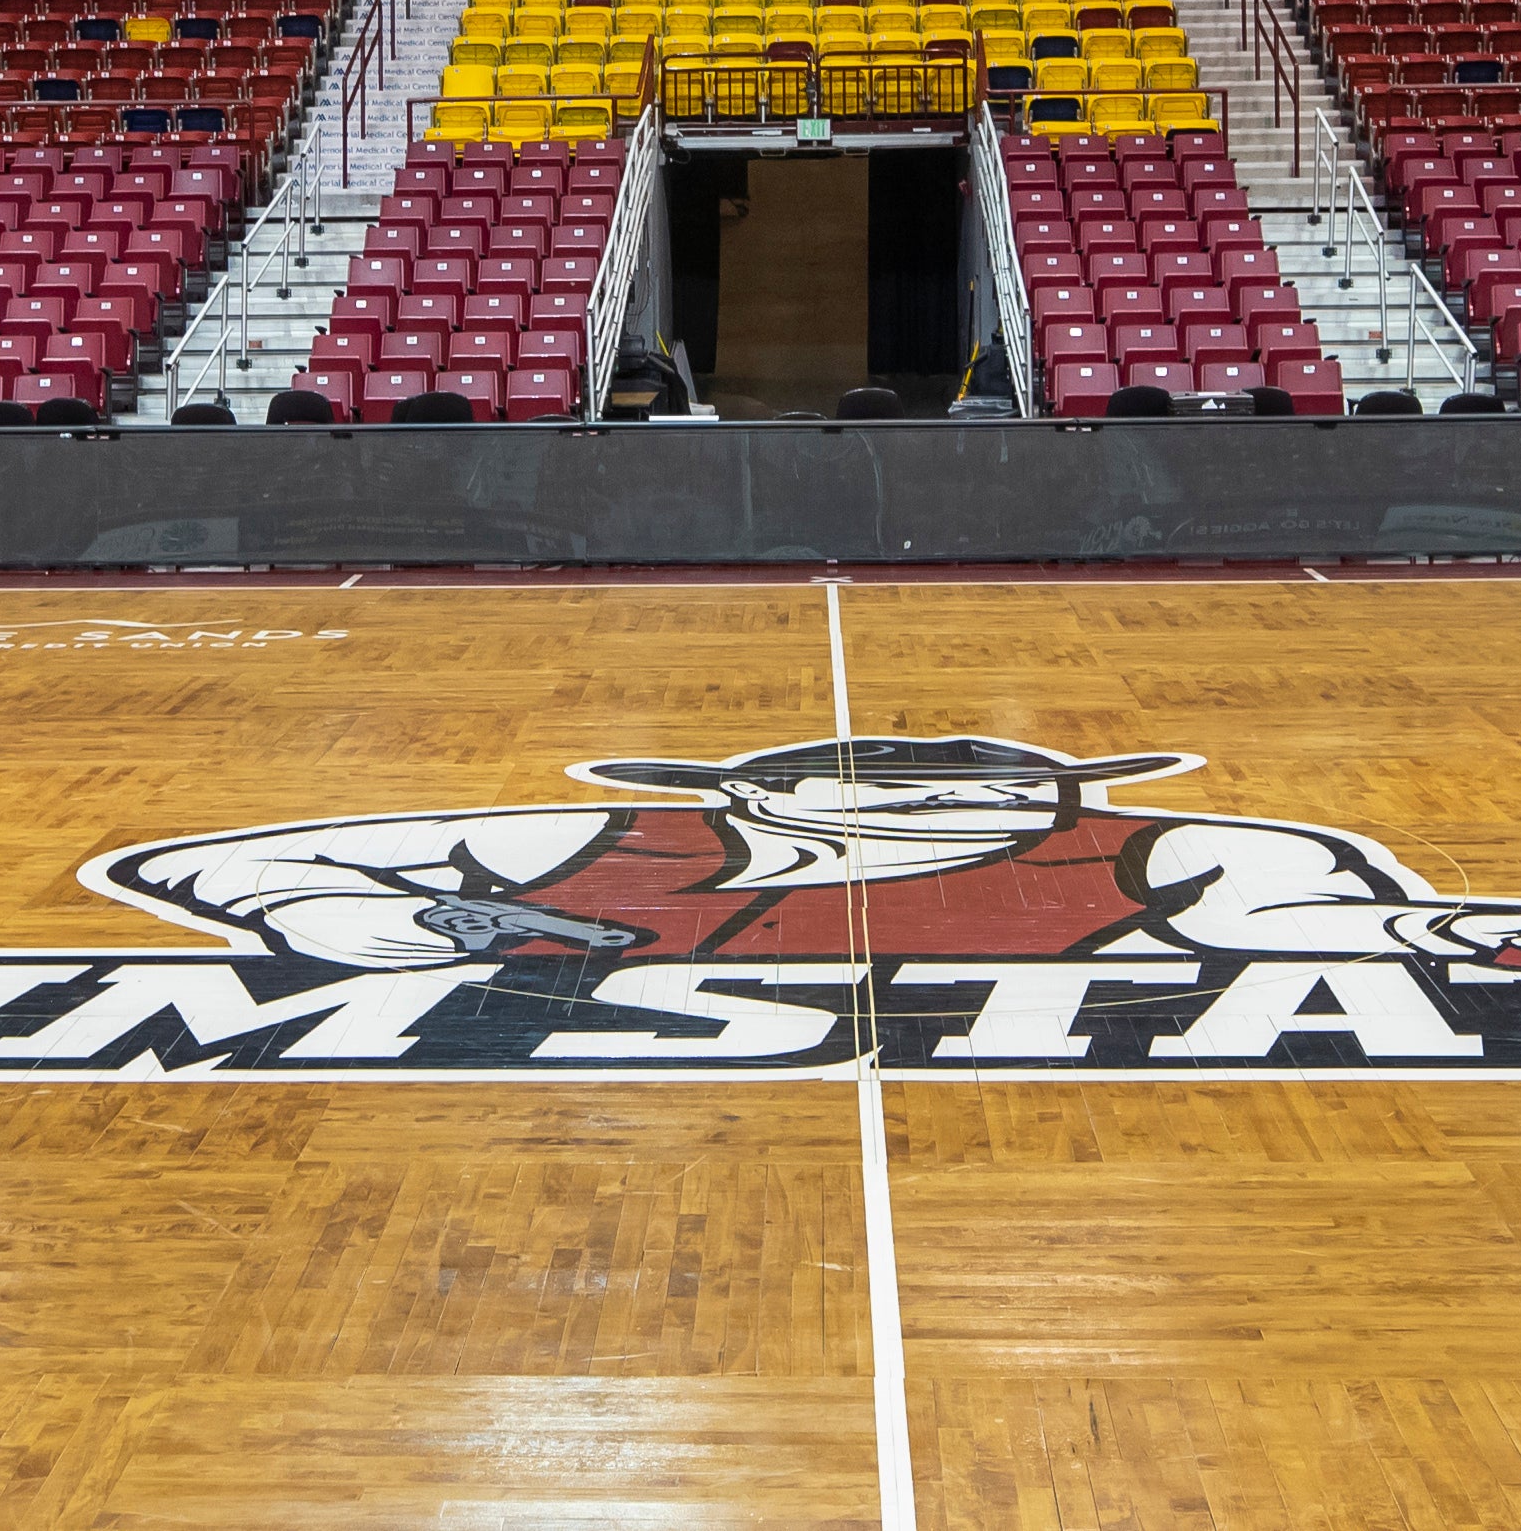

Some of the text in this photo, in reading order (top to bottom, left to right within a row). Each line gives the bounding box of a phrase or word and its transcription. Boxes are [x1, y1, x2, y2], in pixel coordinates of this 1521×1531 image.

[372, 99, 403, 107] Medical
[802, 120, 826, 137] EXIT
[356, 146, 388, 155] Medical
[350, 163, 383, 171] Medical
[73, 630, 350, 641] SANDS
[130, 641, 268, 649] UNION
